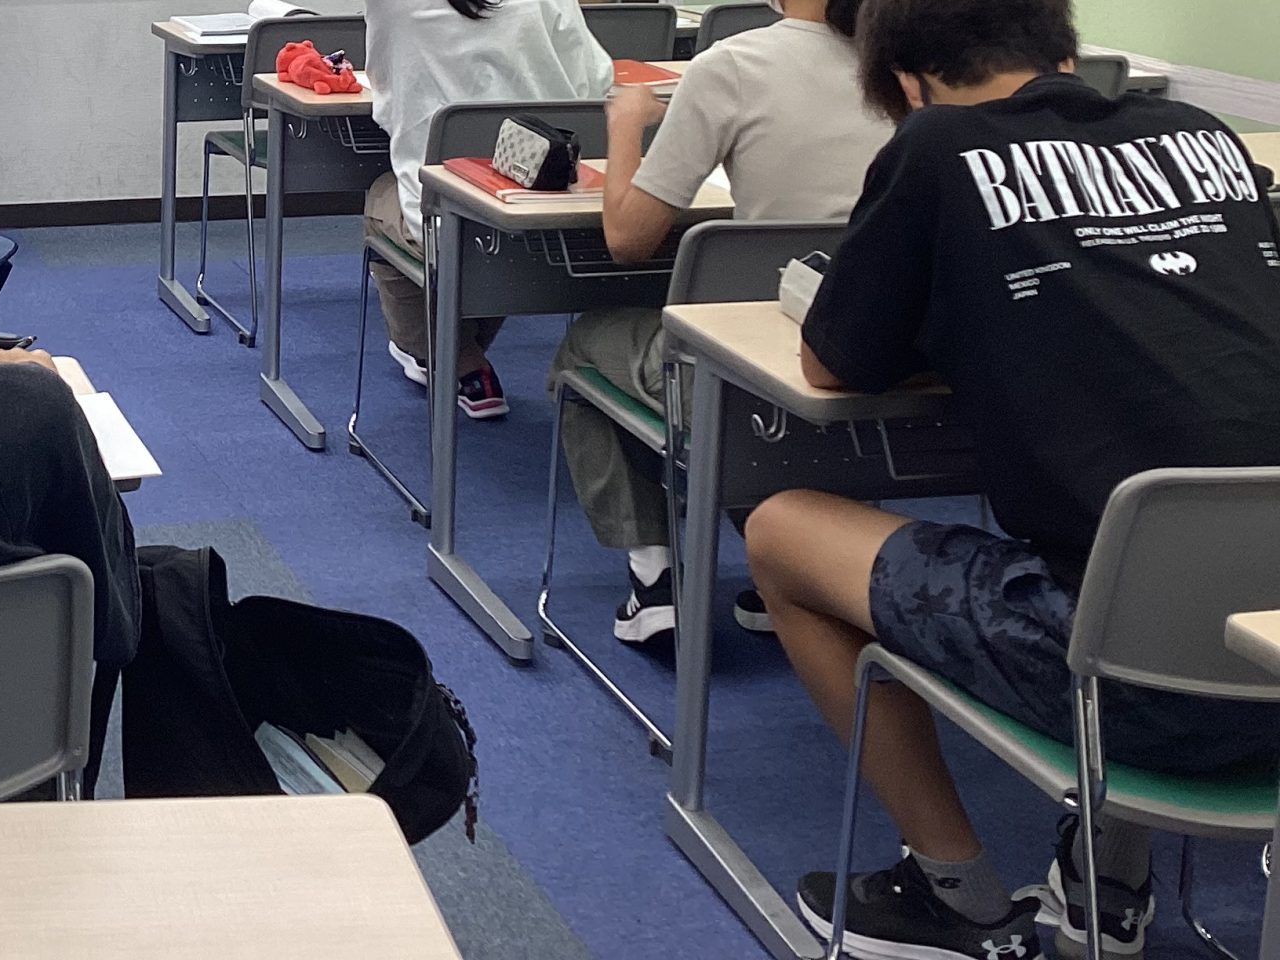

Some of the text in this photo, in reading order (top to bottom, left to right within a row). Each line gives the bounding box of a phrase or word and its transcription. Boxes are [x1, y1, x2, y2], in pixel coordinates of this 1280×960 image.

[958, 129, 1259, 230] BATMAN 1989
[1074, 227, 1102, 237] ONLY
[1102, 227, 1125, 236] ONE
[1122, 224, 1149, 235] WILL
[1147, 220, 1181, 232] CLAIM
[1179, 214, 1201, 226] THE
[1173, 225, 1201, 239] JUNE
